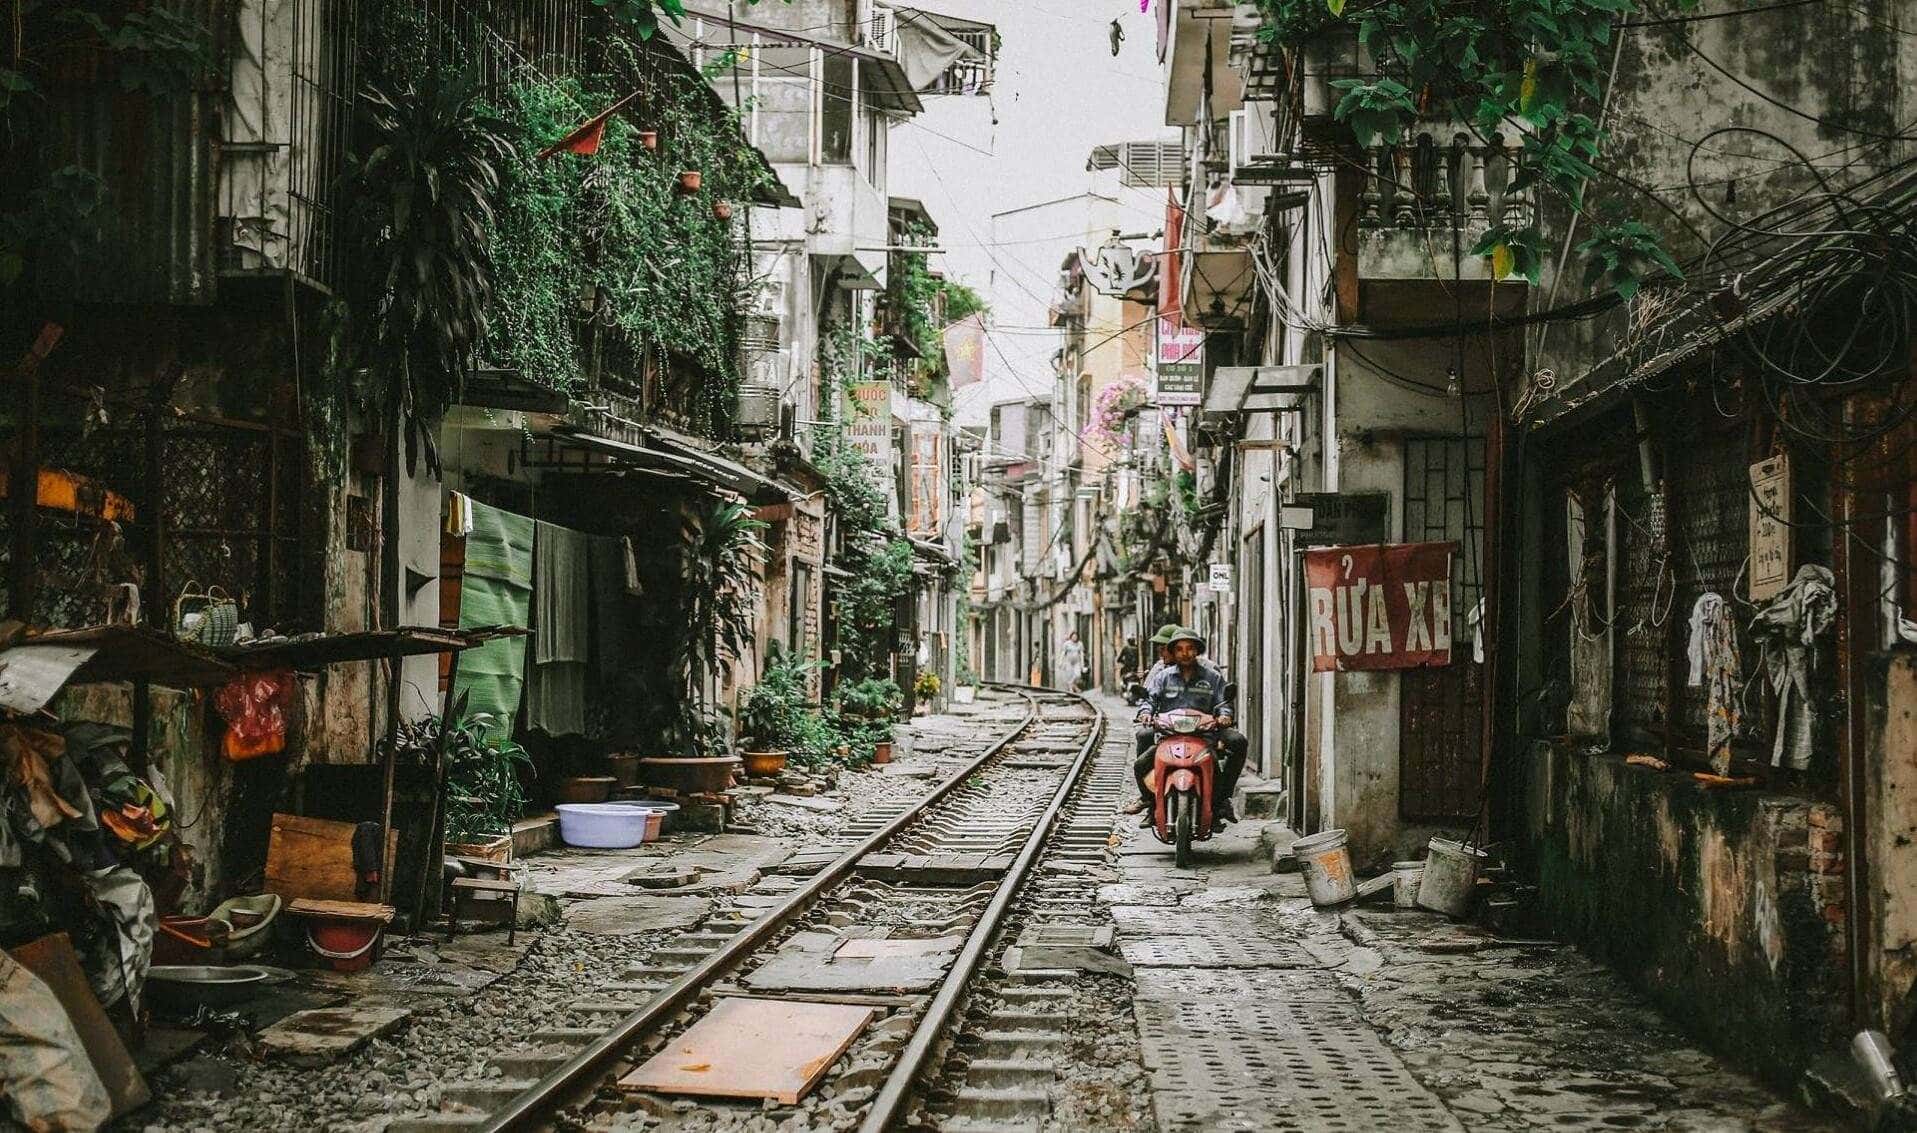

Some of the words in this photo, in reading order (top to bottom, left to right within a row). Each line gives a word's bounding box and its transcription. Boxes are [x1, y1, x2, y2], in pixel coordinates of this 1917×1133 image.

[847, 424, 886, 436] THANH
[1310, 554, 1392, 656] RỬA
[1403, 580, 1450, 652] XE
